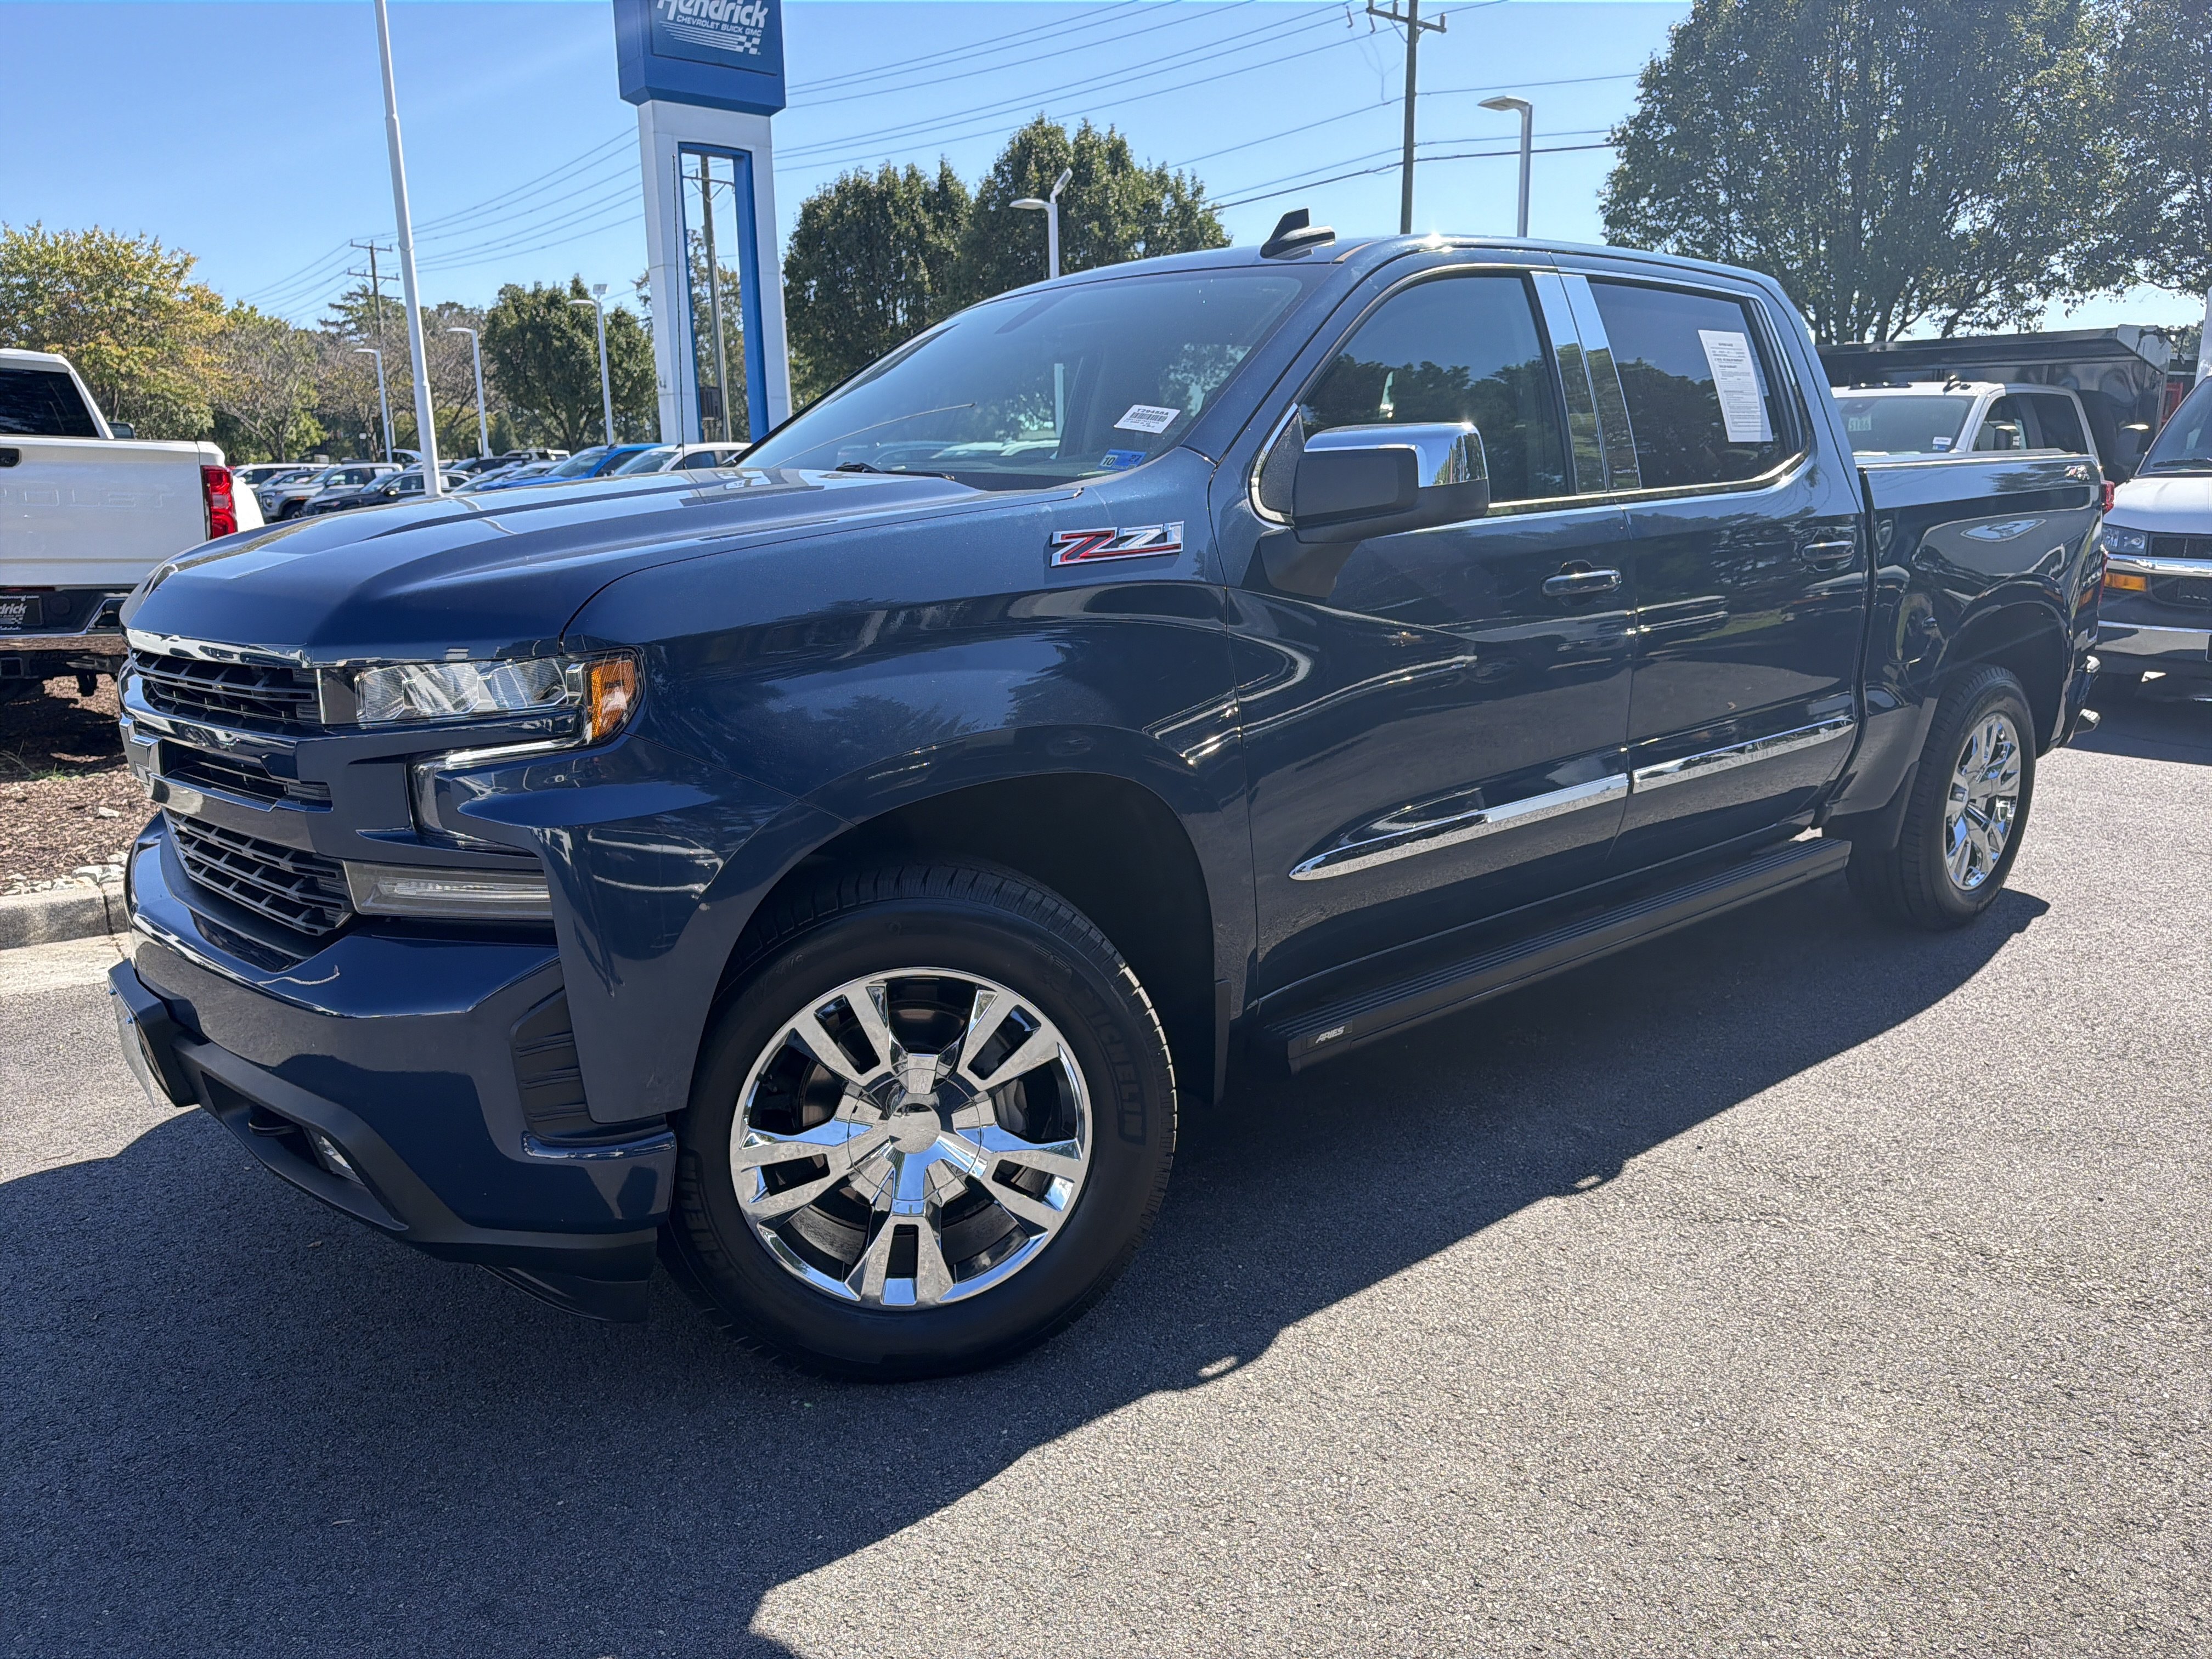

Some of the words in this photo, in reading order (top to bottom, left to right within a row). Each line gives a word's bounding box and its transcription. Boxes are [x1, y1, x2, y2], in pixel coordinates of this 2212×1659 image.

[657, 0, 769, 28] Hendrick
[676, 15, 720, 29] CHEVROLET
[721, 24, 743, 33] BUICK
[744, 29, 763, 37] GMC
[1103, 456, 1116, 466] 10
[1051, 521, 1184, 567] Z71
[1316, 1025, 1345, 1043] ARIES
